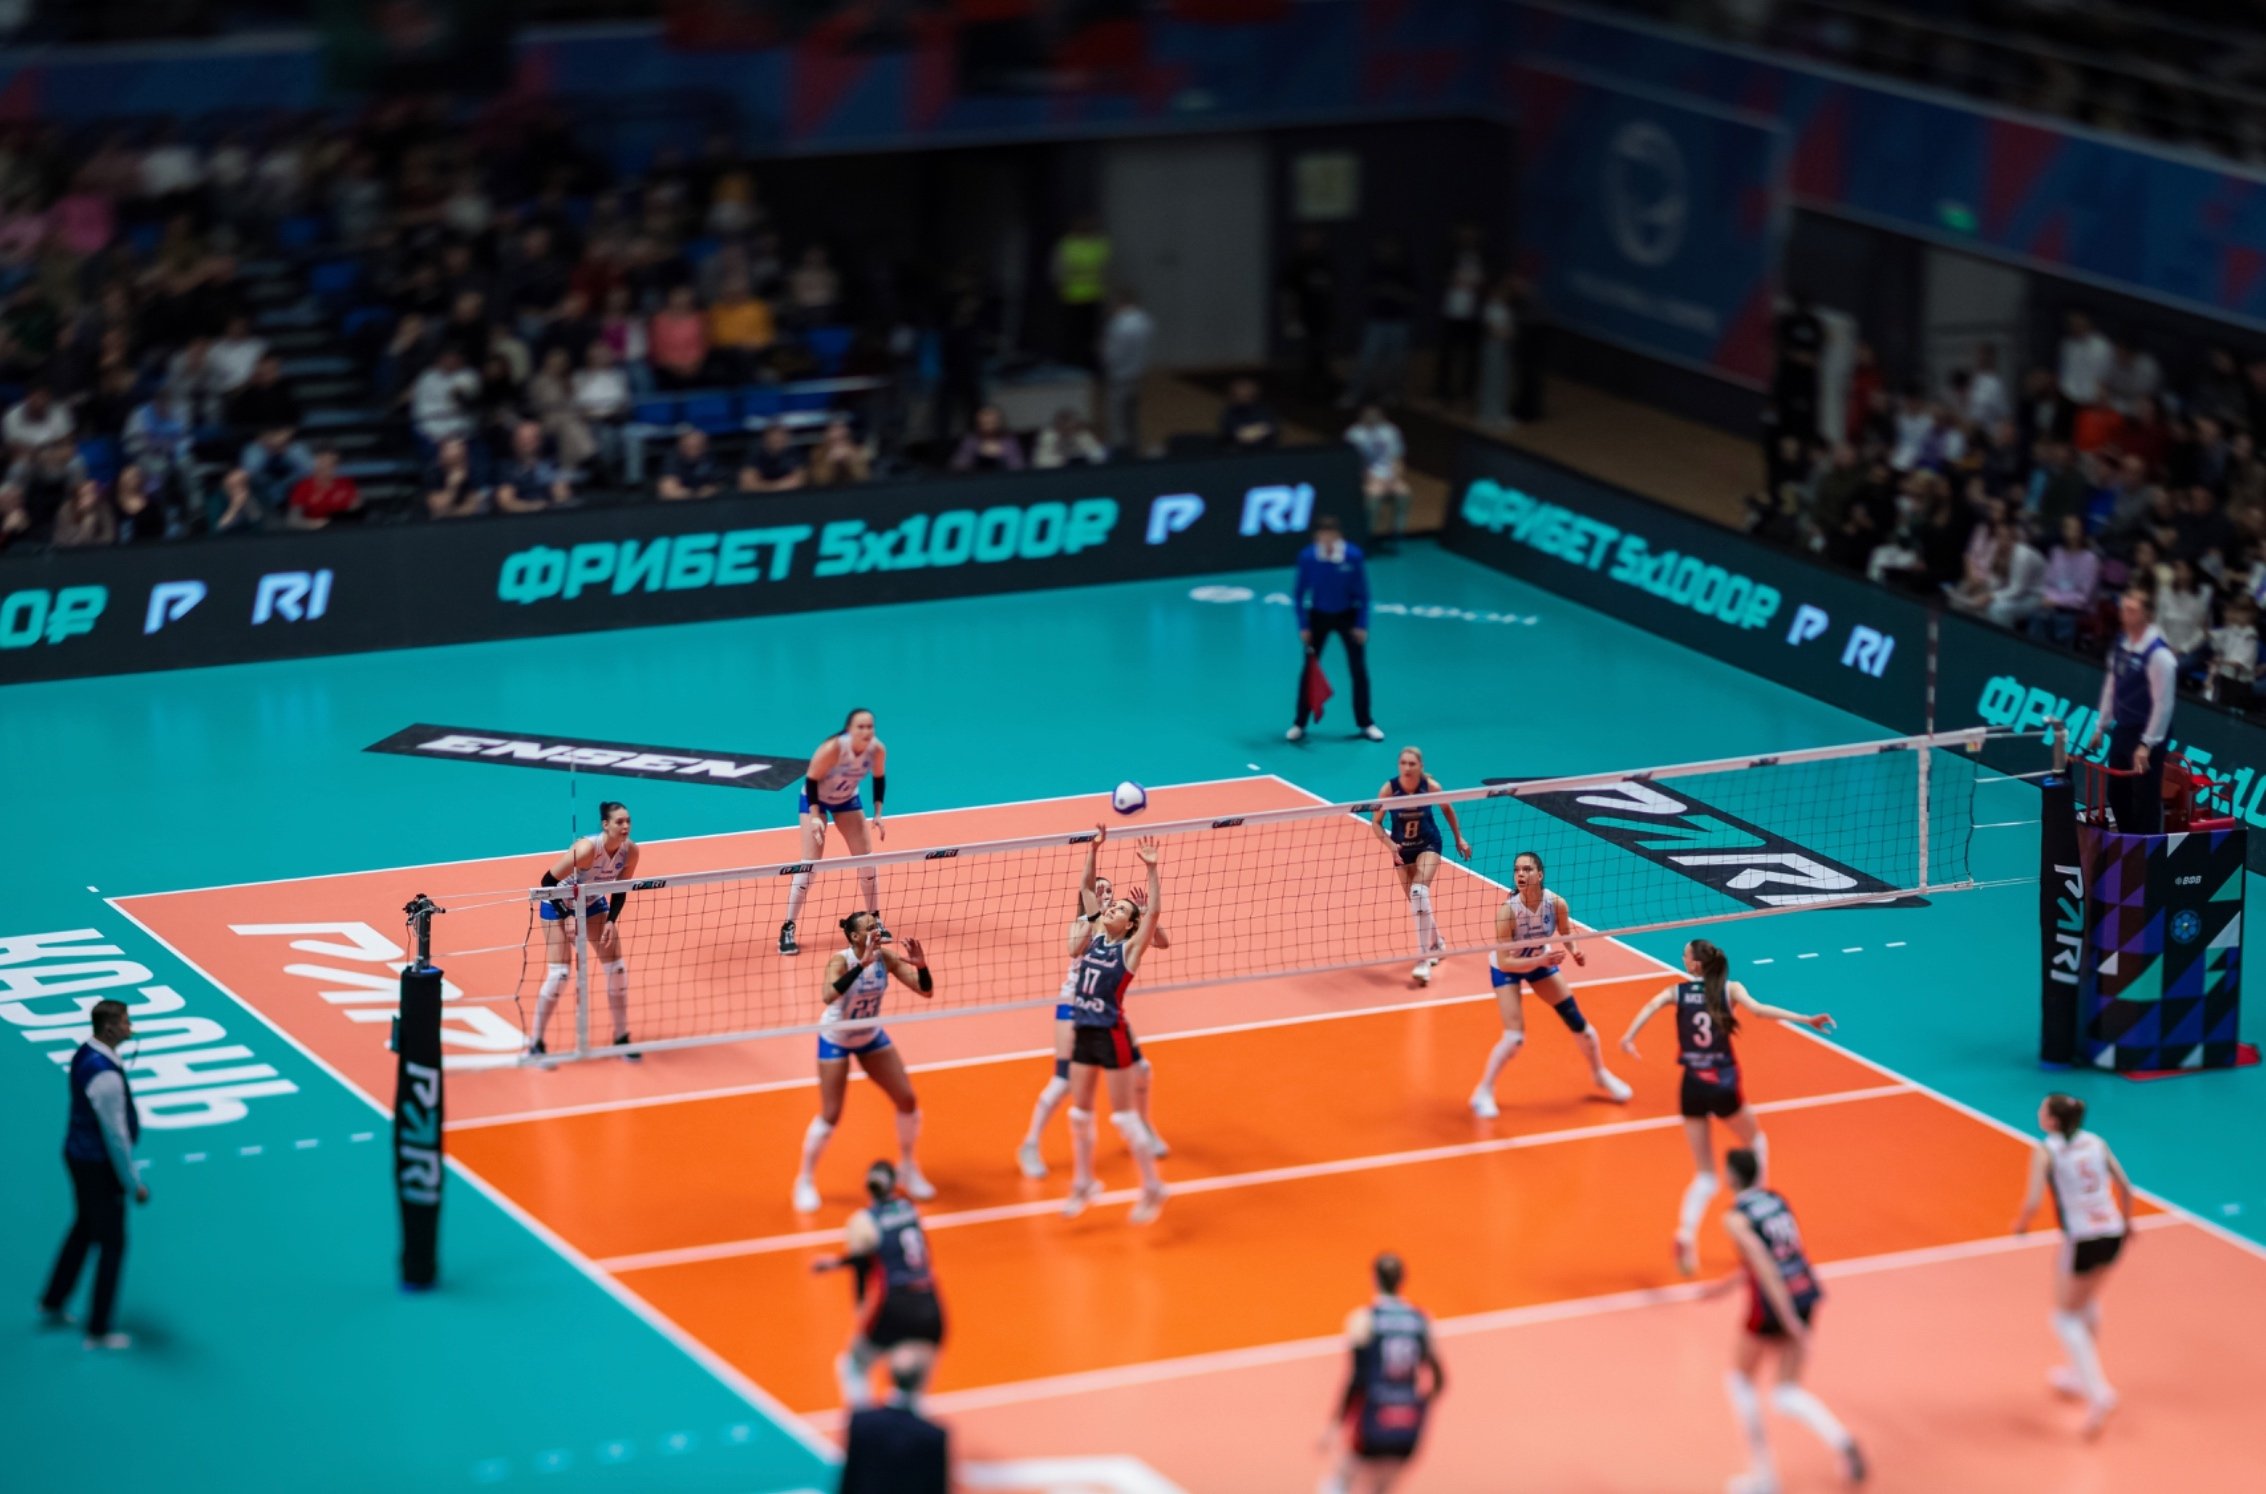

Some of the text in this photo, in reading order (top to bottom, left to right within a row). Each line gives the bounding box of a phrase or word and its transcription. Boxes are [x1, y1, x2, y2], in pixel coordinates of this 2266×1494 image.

[1462, 478, 1620, 571] ФРИБЕТ
[498, 525, 813, 604] ФРИБЕТ
[416, 734, 773, 779] ENSEN
[1404, 820, 1420, 839] 8
[1540, 780, 1898, 906] PARI
[2051, 863, 2085, 984] PARI
[1082, 967, 1101, 994] 17
[1692, 1010, 1713, 1048] 3
[399, 1061, 441, 1206] PARI
